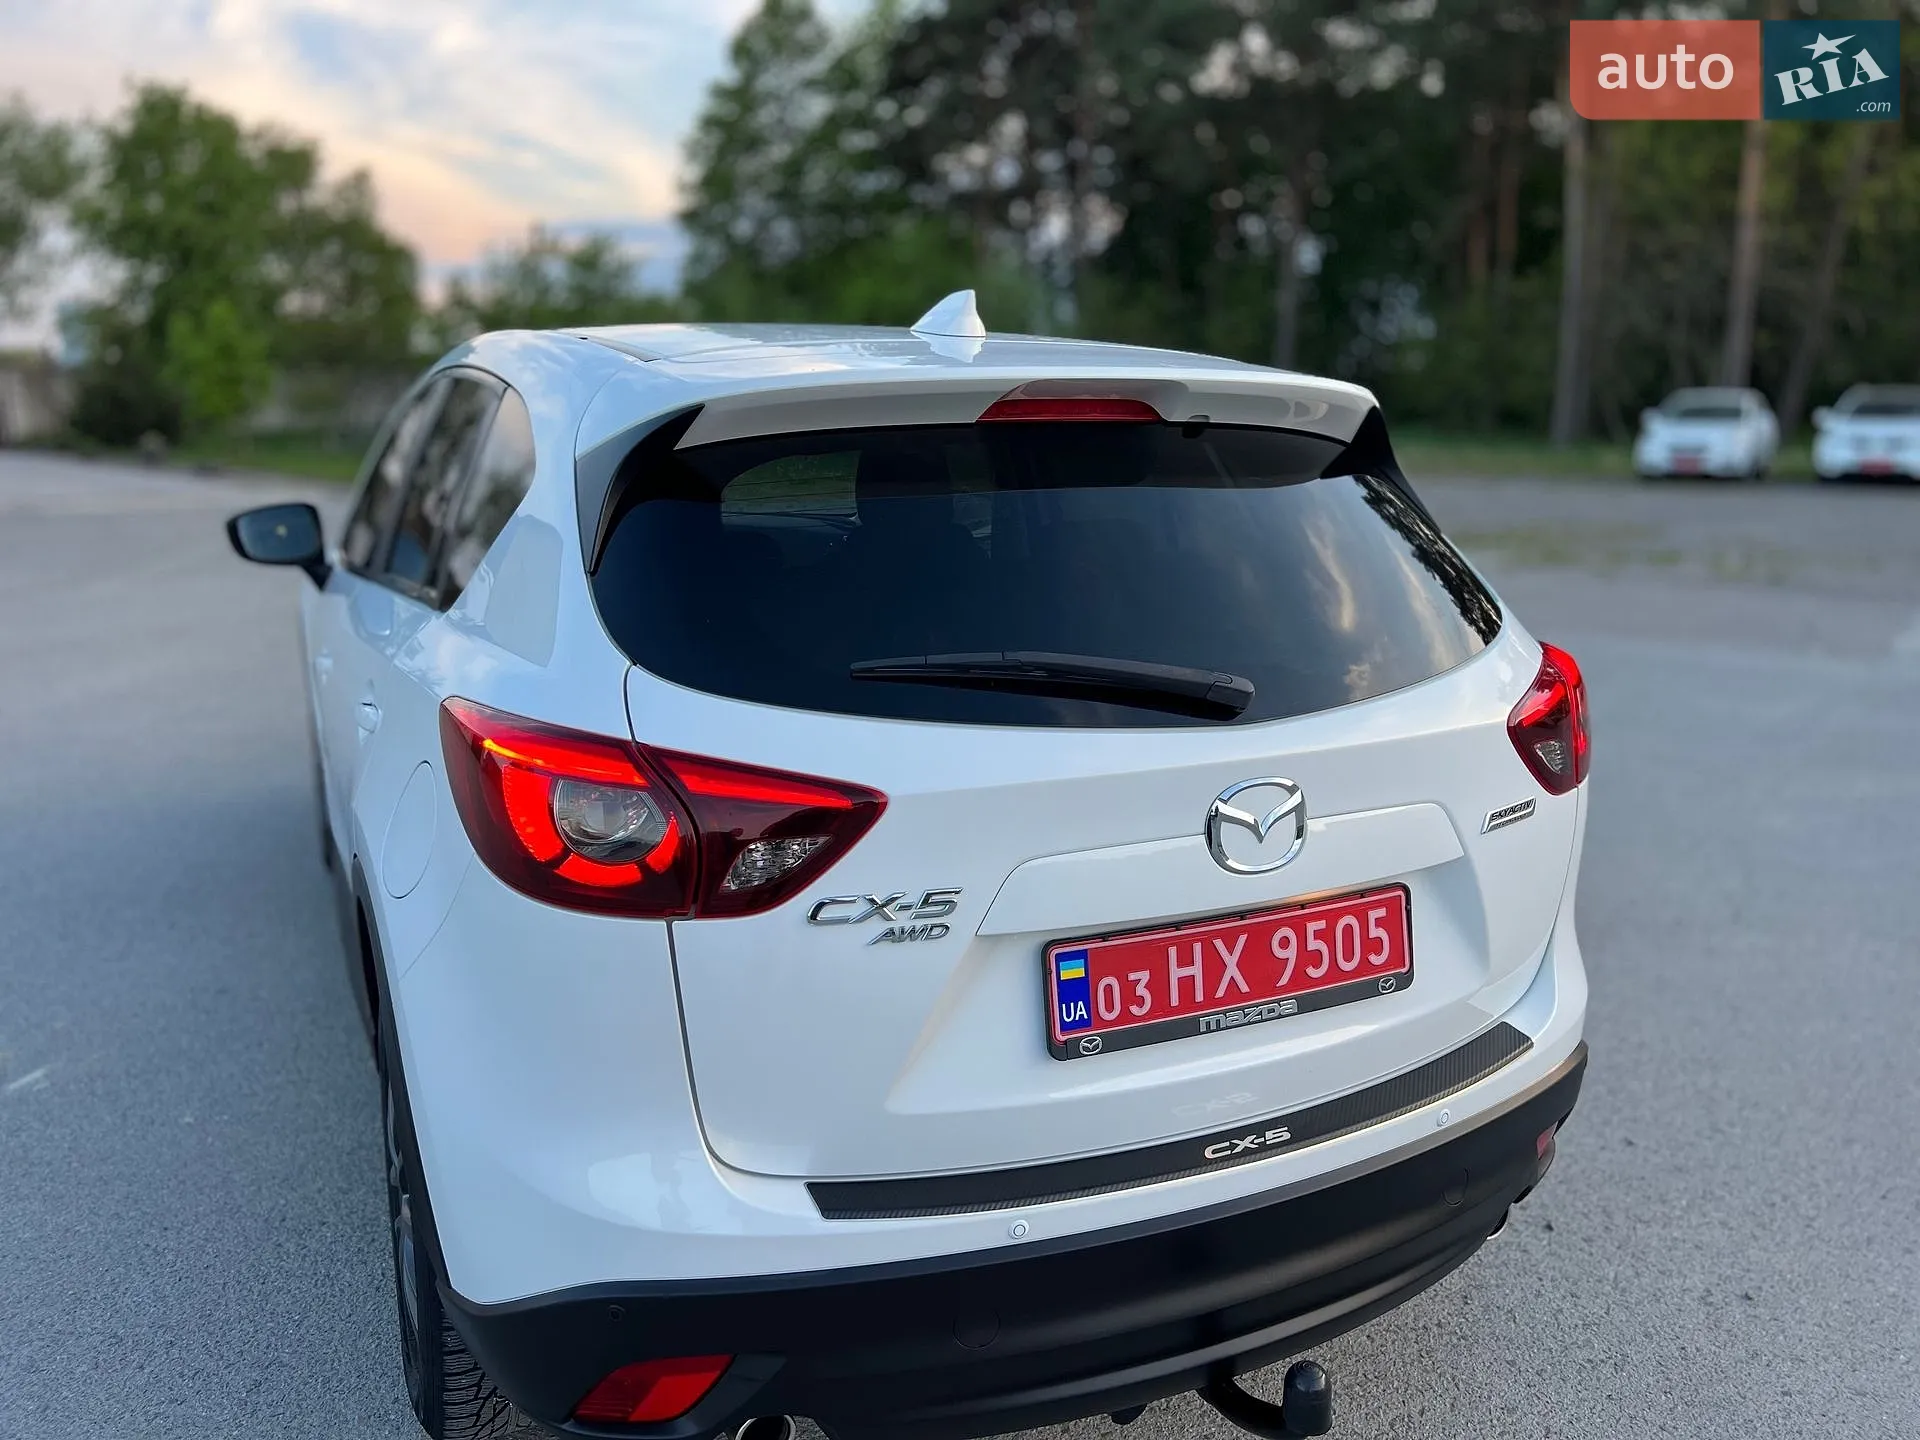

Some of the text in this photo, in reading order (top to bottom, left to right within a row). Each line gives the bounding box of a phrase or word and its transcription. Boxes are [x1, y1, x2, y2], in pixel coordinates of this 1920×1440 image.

[807, 886, 964, 925] CX-5
[867, 922, 951, 946] AWD
[1097, 908, 1390, 1021] 03 HX 9505
[1062, 1000, 1088, 1023] UA
[1204, 1126, 1291, 1159] CX-5
